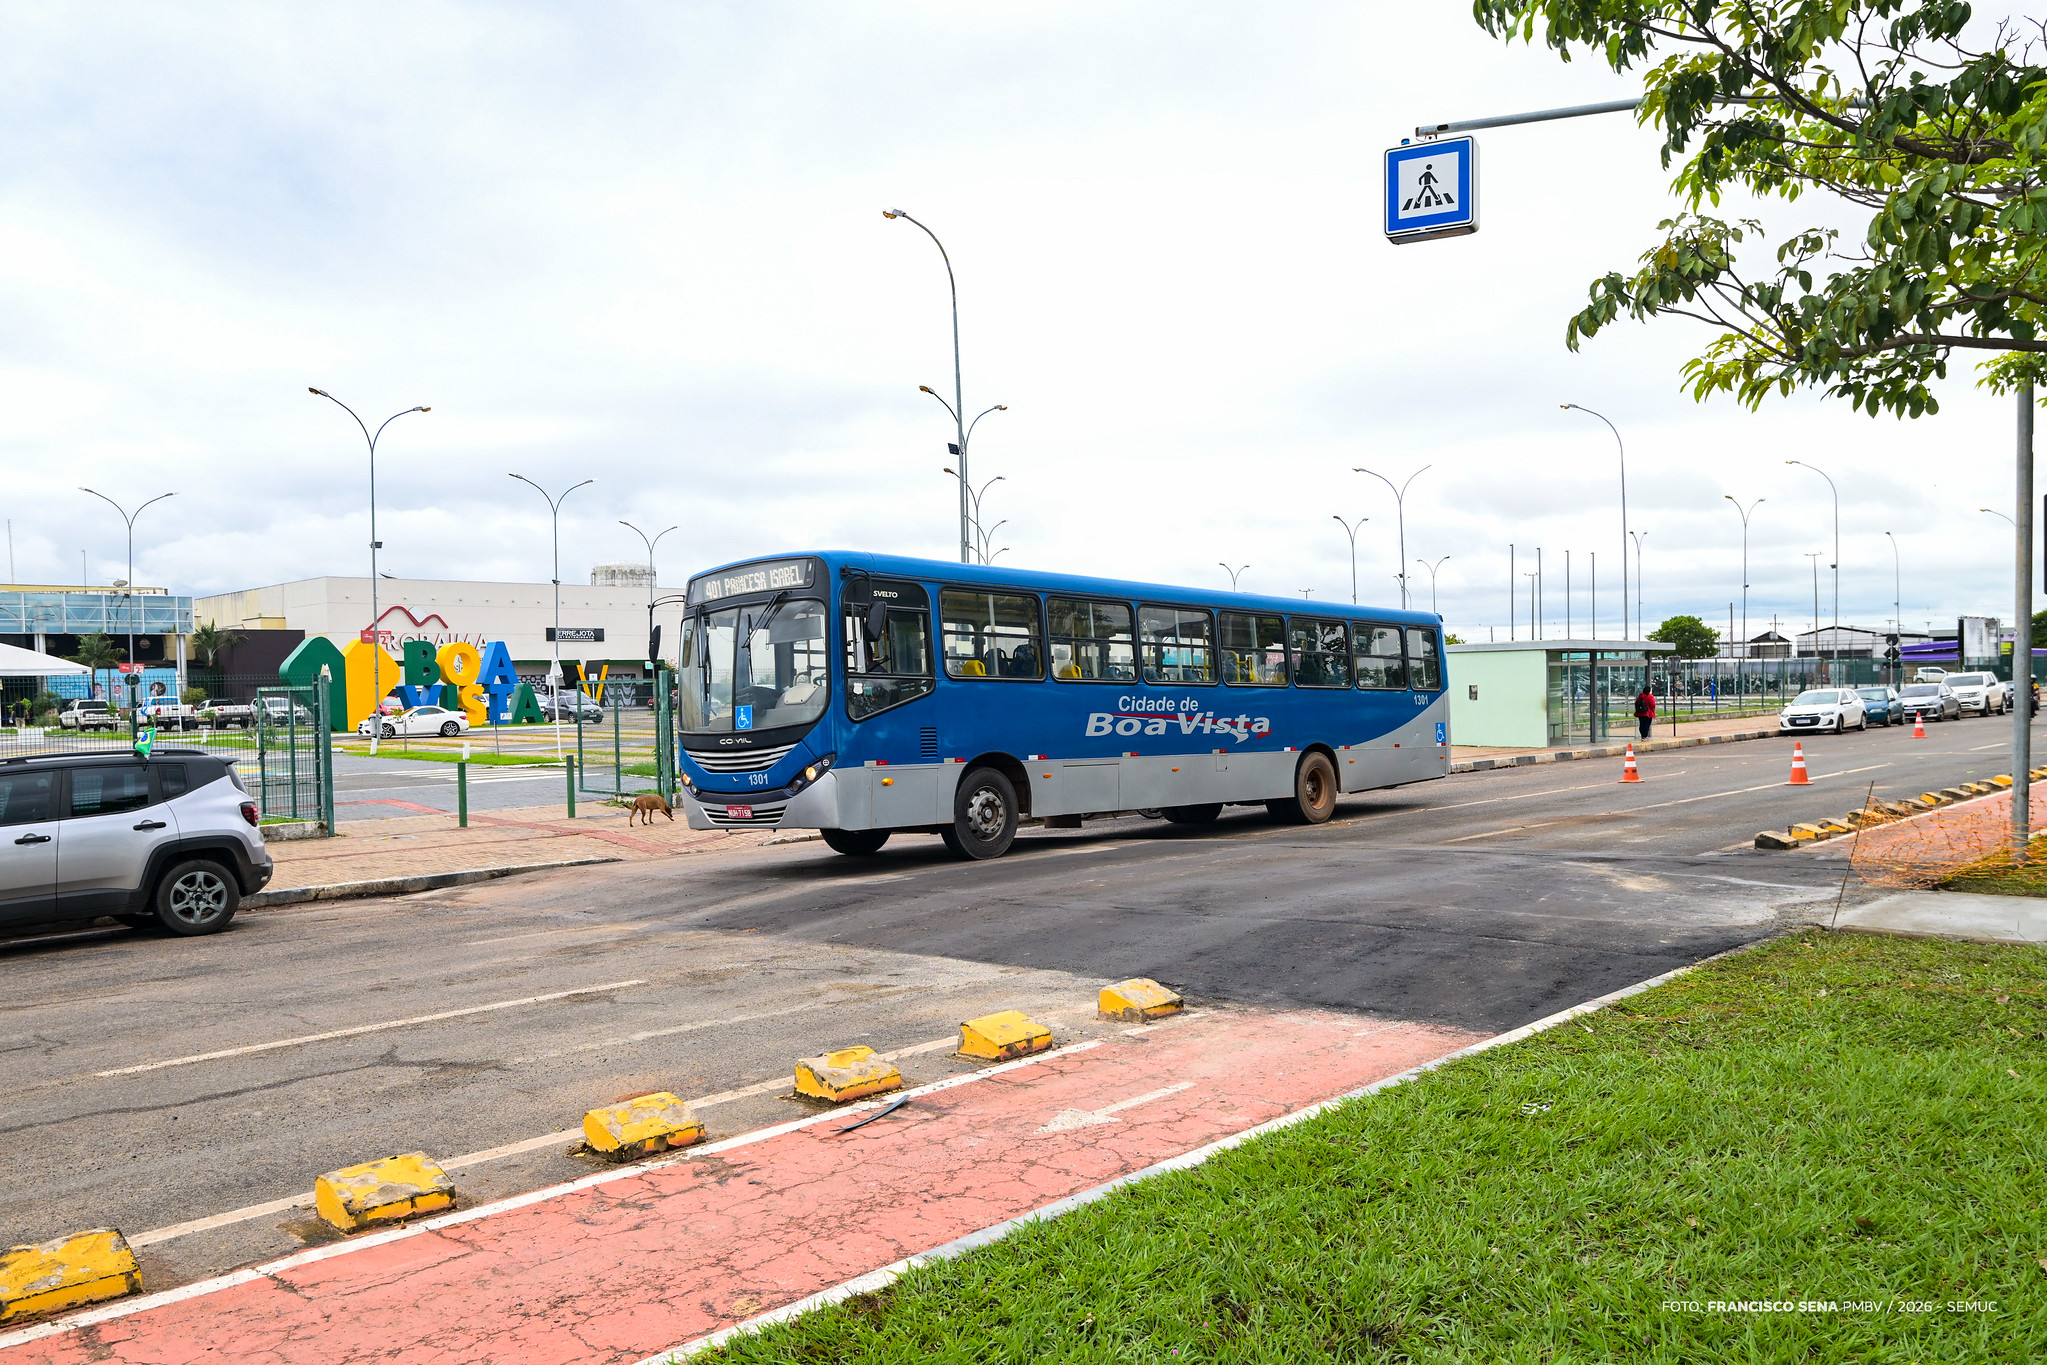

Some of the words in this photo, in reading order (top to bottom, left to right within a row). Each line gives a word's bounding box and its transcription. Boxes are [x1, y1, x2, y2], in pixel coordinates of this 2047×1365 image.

[705, 580, 722, 600] 401
[724, 572, 767, 596] PRINCESA
[769, 565, 804, 588] ISABEL
[873, 590, 898, 599] SVELTO
[404, 640, 519, 686] BOA
[396, 683, 545, 726] VISTA
[1118, 695, 1176, 712] Cidade
[1180, 696, 1199, 712] de
[1413, 694, 1429, 706] 1301
[1085, 712, 1167, 737] Boa
[1176, 711, 1271, 735] Vista
[748, 773, 769, 786] 1301
